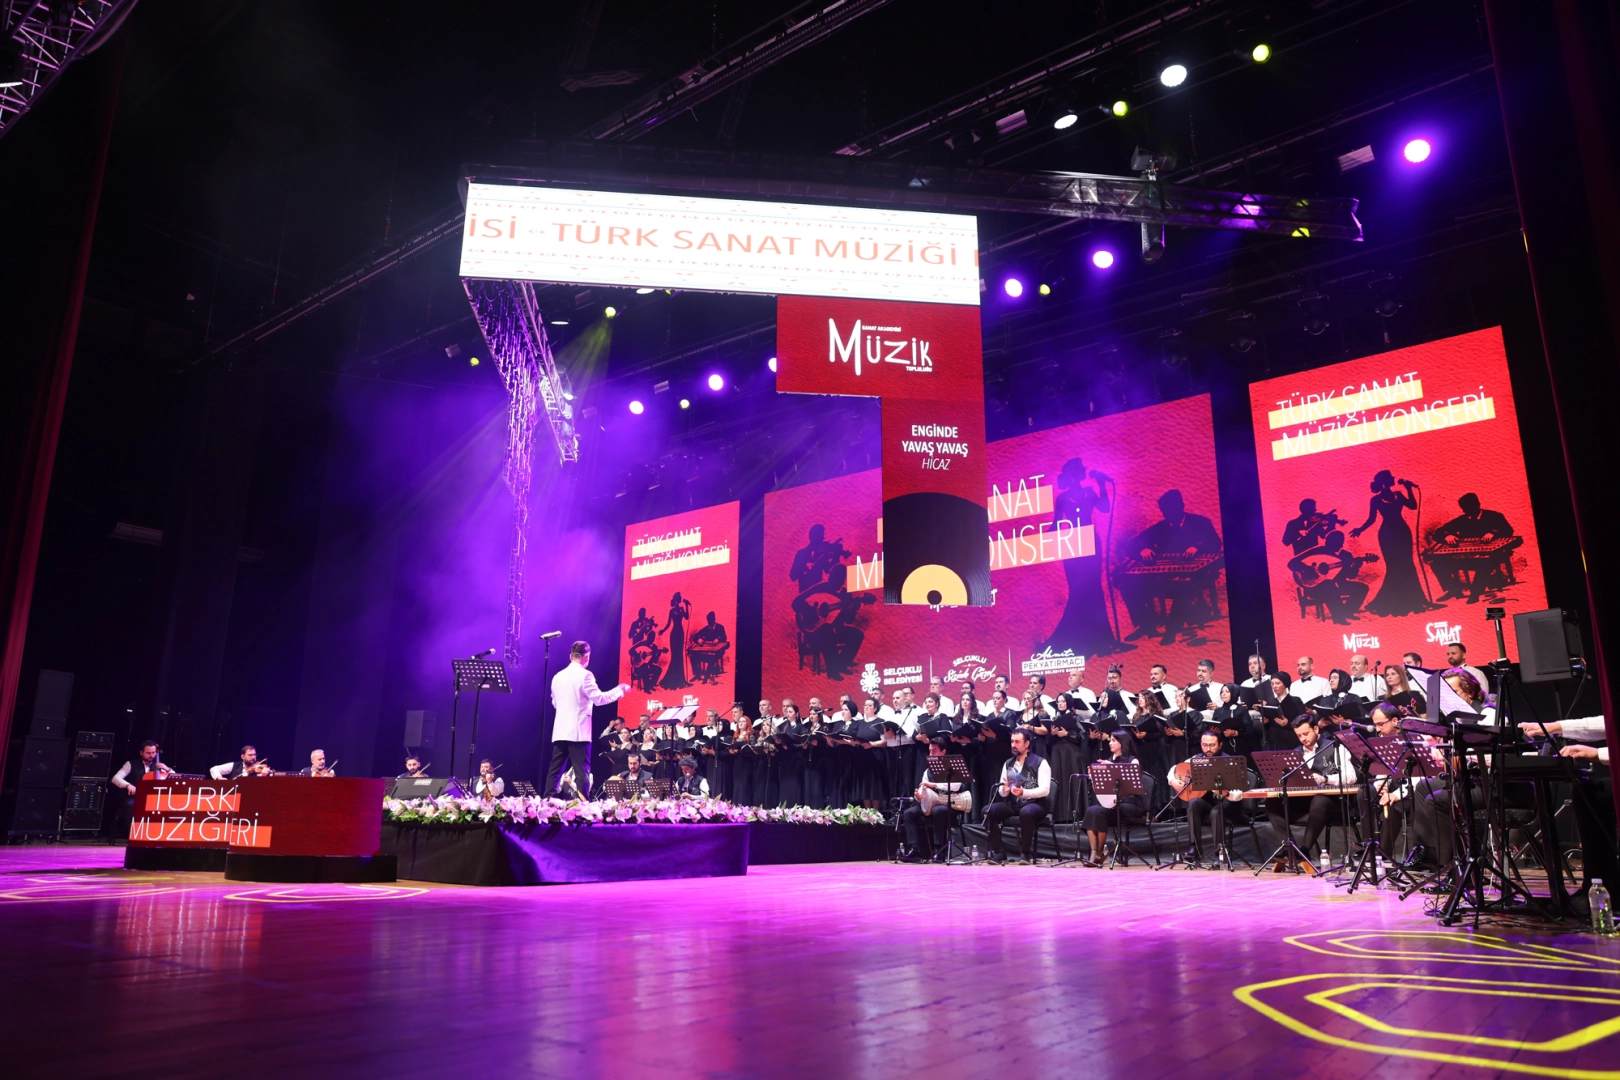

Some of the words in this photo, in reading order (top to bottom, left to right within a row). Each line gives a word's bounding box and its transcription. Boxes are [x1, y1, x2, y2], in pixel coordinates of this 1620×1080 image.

[469, 213, 517, 239] İSİ
[552, 219, 659, 248] TÜRK
[672, 230, 802, 255] SANAT
[815, 236, 958, 266] MÜZİĞİ
[1276, 391, 1336, 427] TÜRK
[1342, 371, 1419, 413] SANAT
[911, 423, 959, 438] ENGİNDE
[1282, 410, 1370, 459] MÜZİĞİ
[1375, 385, 1489, 439] KONSERİ
[902, 440, 935, 456] YAVAŞ
[936, 442, 969, 458] YAVAŞ
[921, 456, 951, 471] HİCAZ
[883, 665, 923, 676] SELÇUKLU
[883, 674, 923, 685] BELEDİYESİ
[153, 781, 235, 811] TÜRK
[129, 811, 229, 842] MÜZİĞİ
